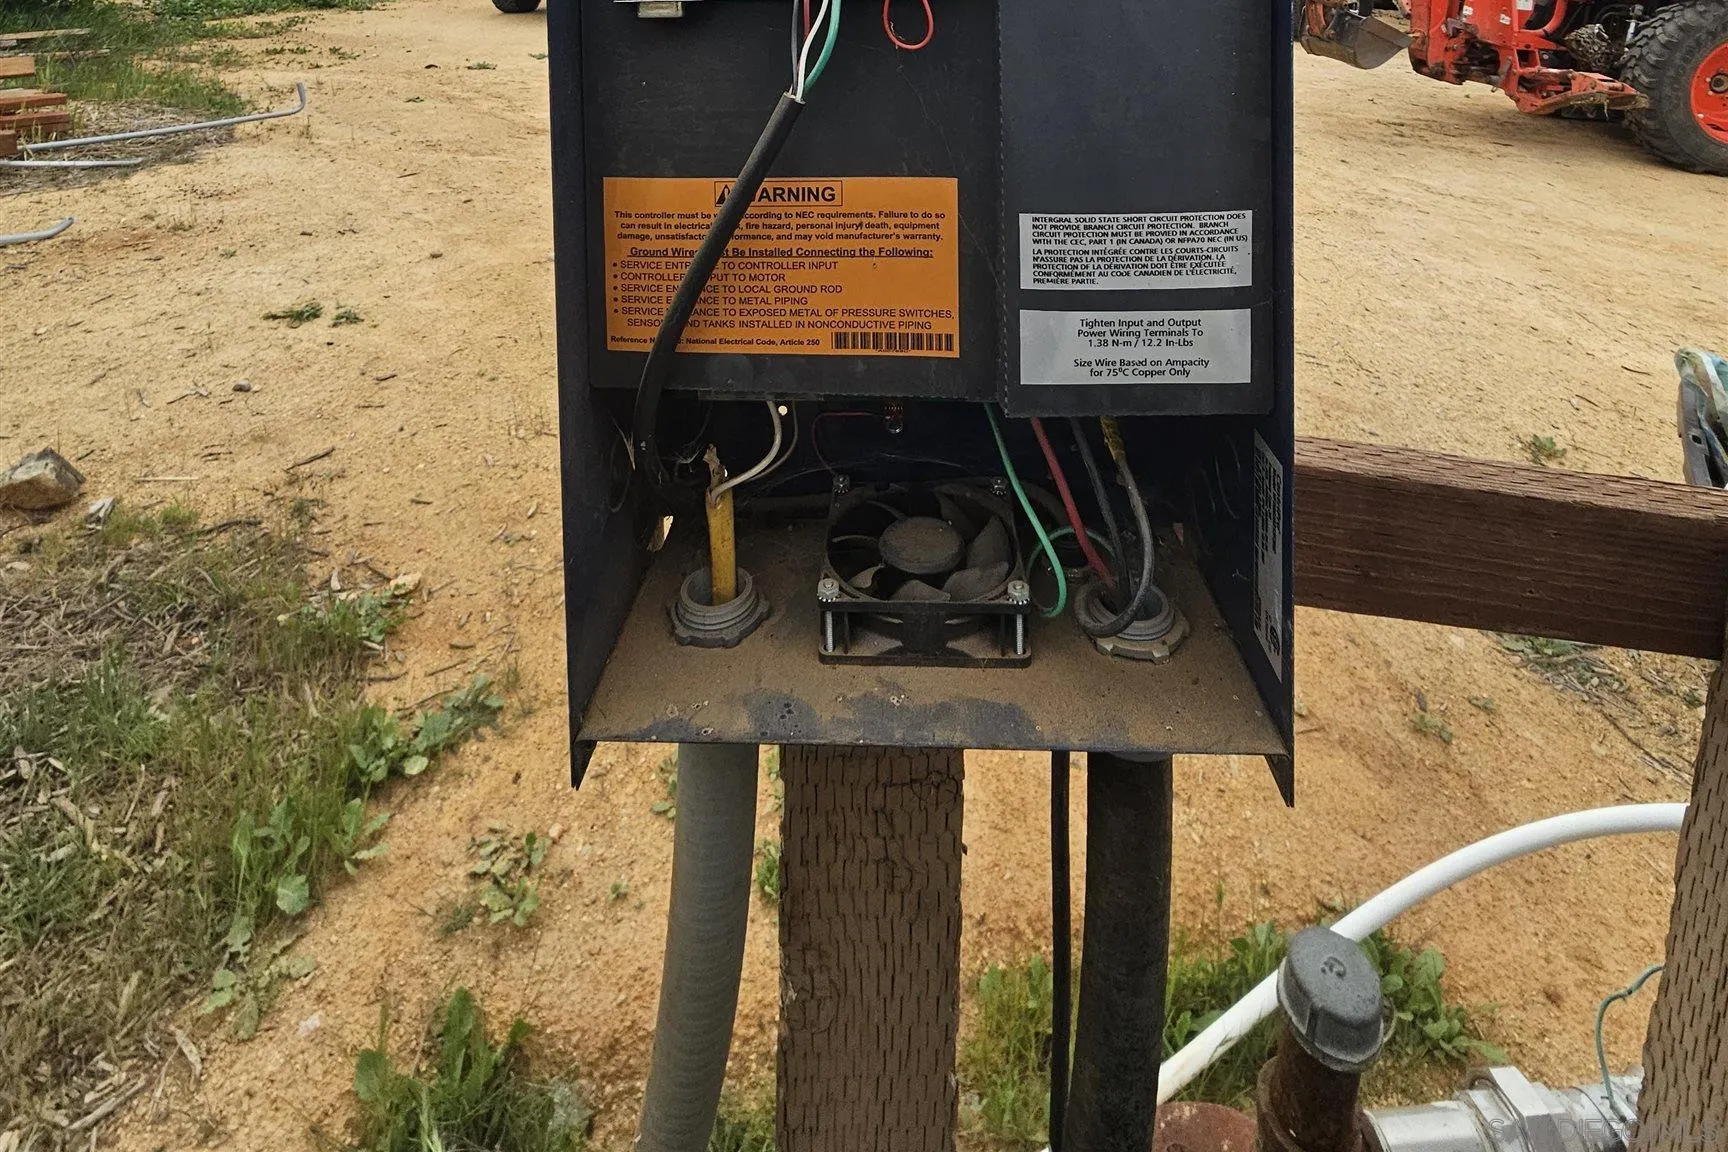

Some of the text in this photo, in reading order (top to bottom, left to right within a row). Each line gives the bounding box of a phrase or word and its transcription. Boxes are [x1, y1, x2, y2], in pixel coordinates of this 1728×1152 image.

[750, 187, 836, 202] ARNING
[615, 211, 632, 219] This
[817, 211, 876, 220] requirements.
[878, 211, 908, 219] Failure
[1189, 228, 1239, 236] ACCORDANCE
[630, 247, 933, 258] Ground Be Installed Connecting the Following:
[732, 274, 746, 282] TO
[749, 274, 786, 282] MOTOR
[621, 284, 842, 293] SERVICE TO LOCAL GROUND ROD
[622, 307, 663, 316] SERVICE
[739, 309, 786, 317] EXPOSED
[789, 309, 822, 317] METAL
[825, 309, 839, 317] OF
[842, 309, 896, 317] PRESSURE
[899, 309, 955, 319] SWITCHES,
[1080, 318, 1202, 329] Tighten Input and Output
[1078, 329, 1106, 337] Power
[1110, 329, 1141, 339] Wiring
[611, 336, 648, 344] Reference
[1088, 339, 1109, 347] 1.38
[1112, 339, 1132, 347] N-m
[1142, 339, 1162, 347] 12.2
[1166, 339, 1194, 347] In-Lbs
[1074, 359, 1092, 367] Size
[1095, 359, 1117, 367] Wire
[1120, 358, 1147, 367] Based
[1165, 358, 1210, 368] Ampacity
[1090, 368, 1103, 376] for
[1132, 369, 1166, 378] Copper
[1169, 368, 1191, 378] Only
